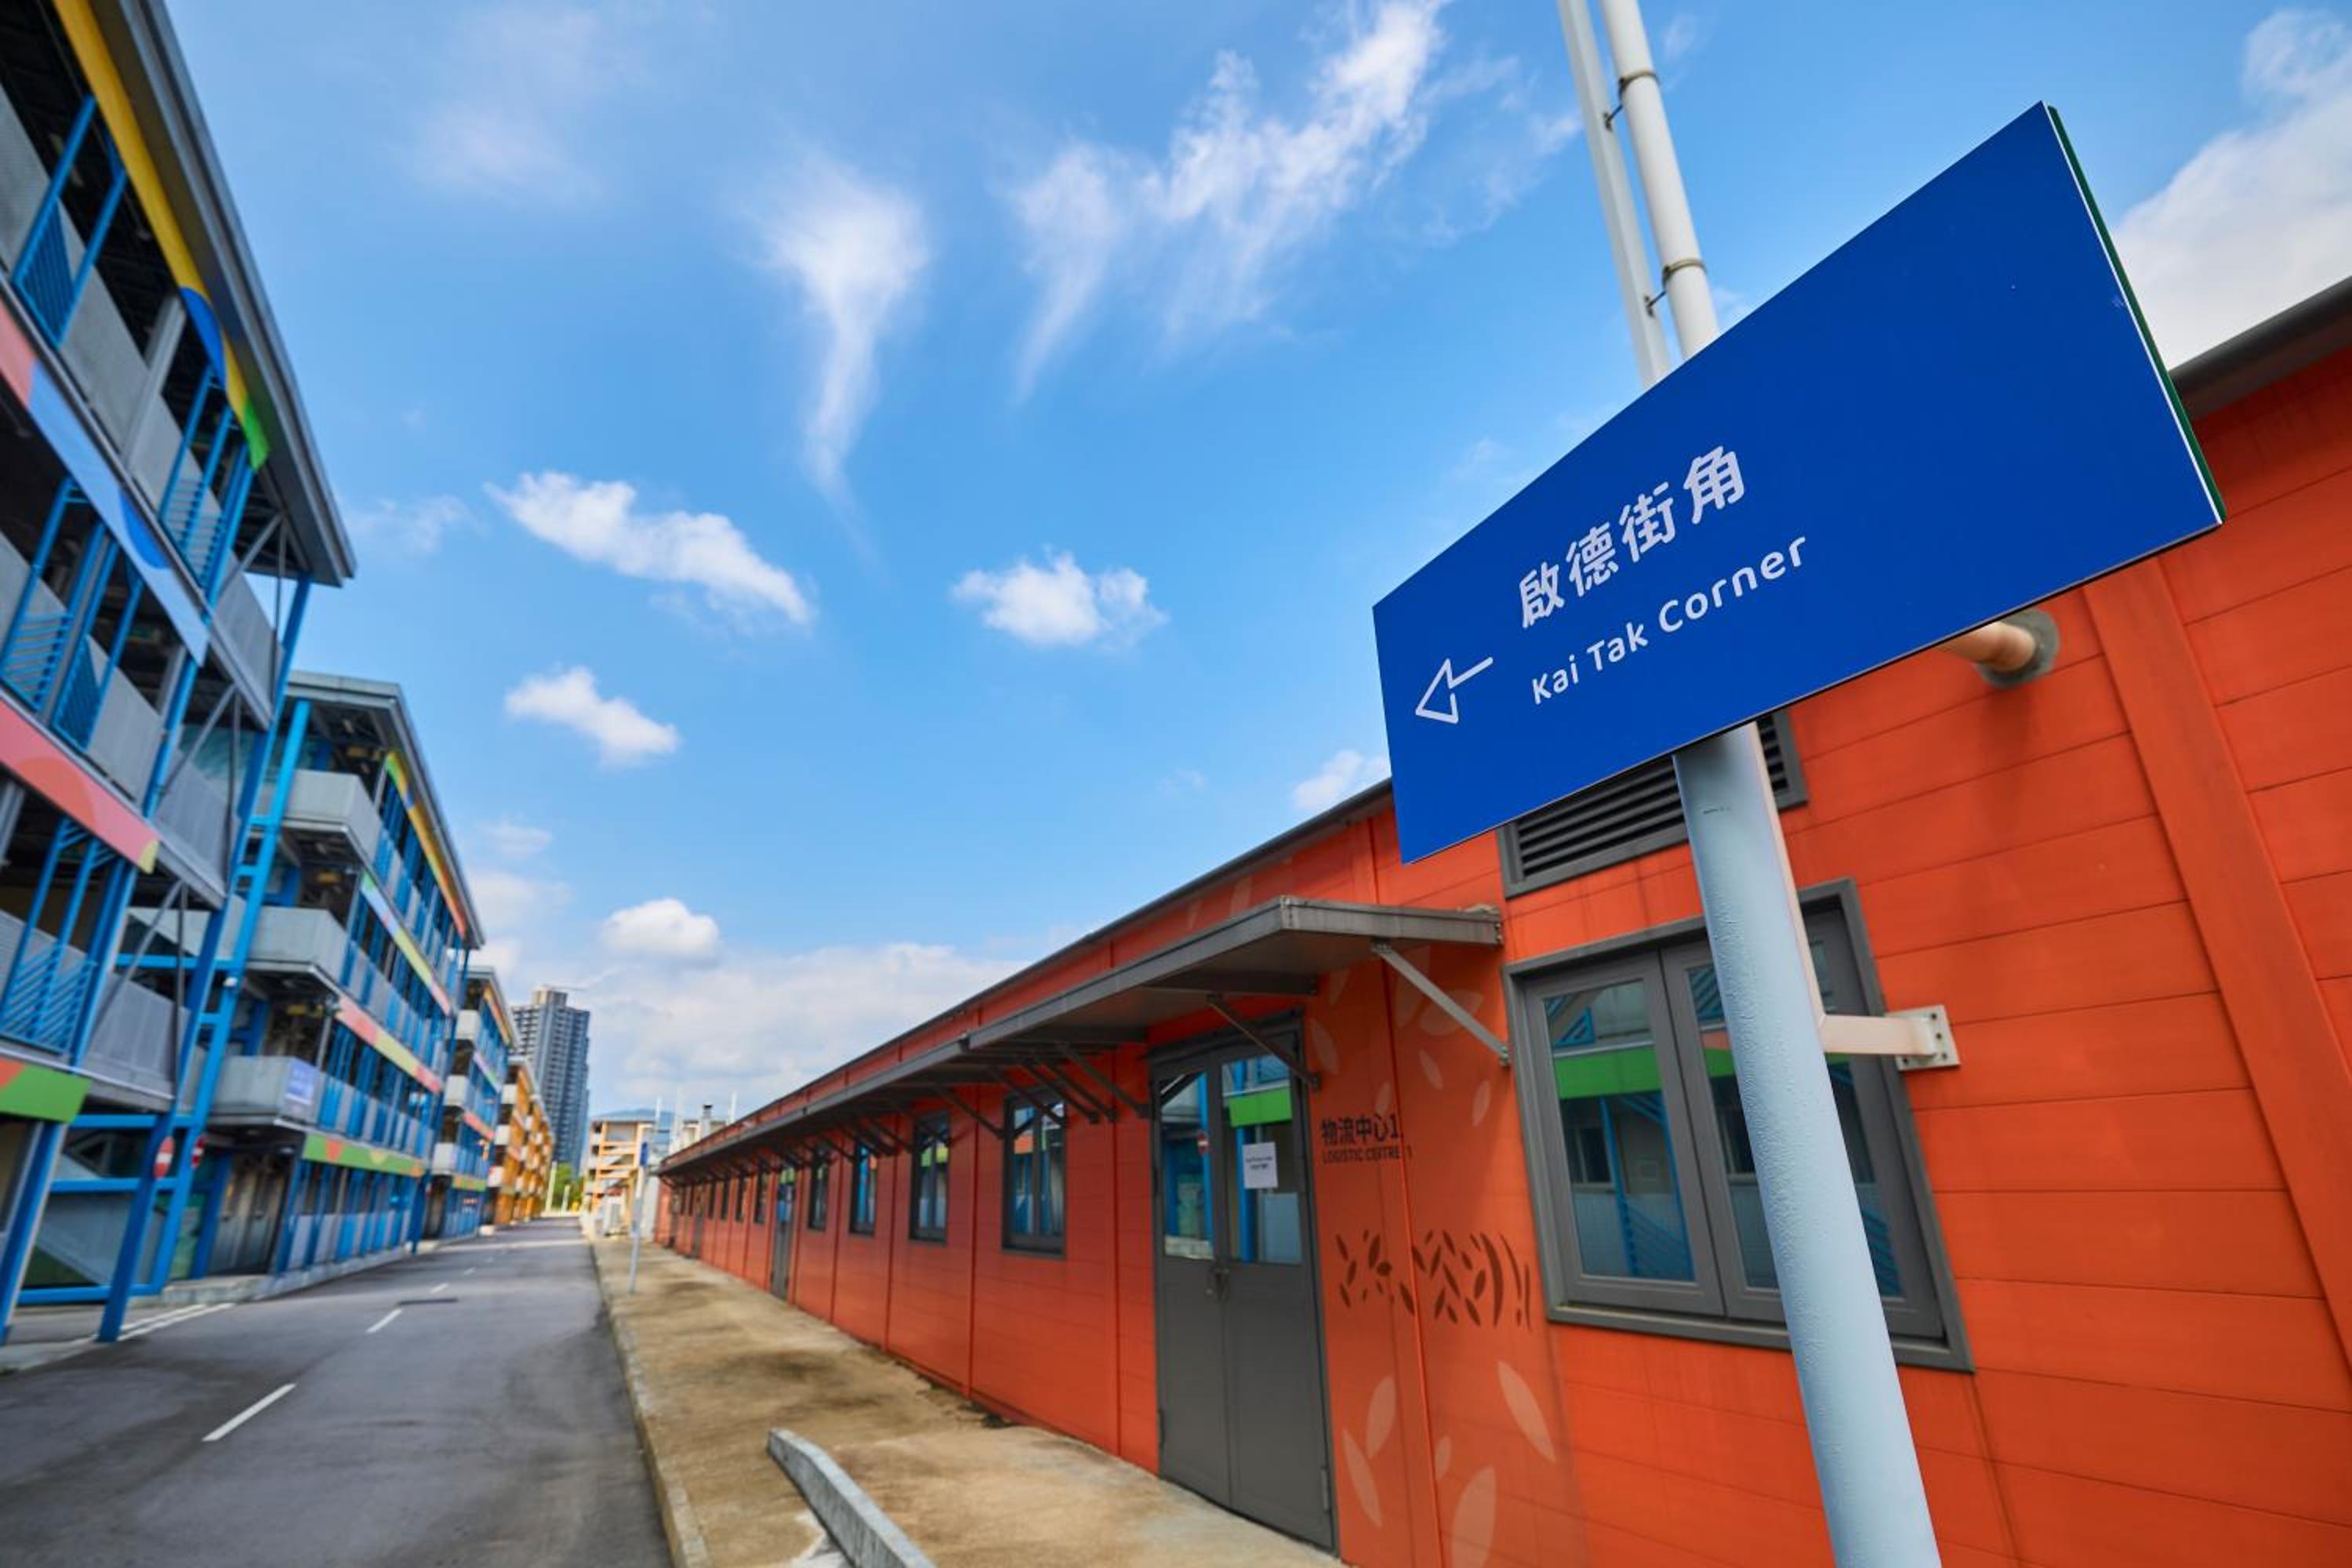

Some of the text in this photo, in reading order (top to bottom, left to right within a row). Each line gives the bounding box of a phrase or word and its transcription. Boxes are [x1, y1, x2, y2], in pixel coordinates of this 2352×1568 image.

[1519, 446, 1745, 629] 啟德街角
[1532, 537, 1806, 704] Kai Tak Corner
